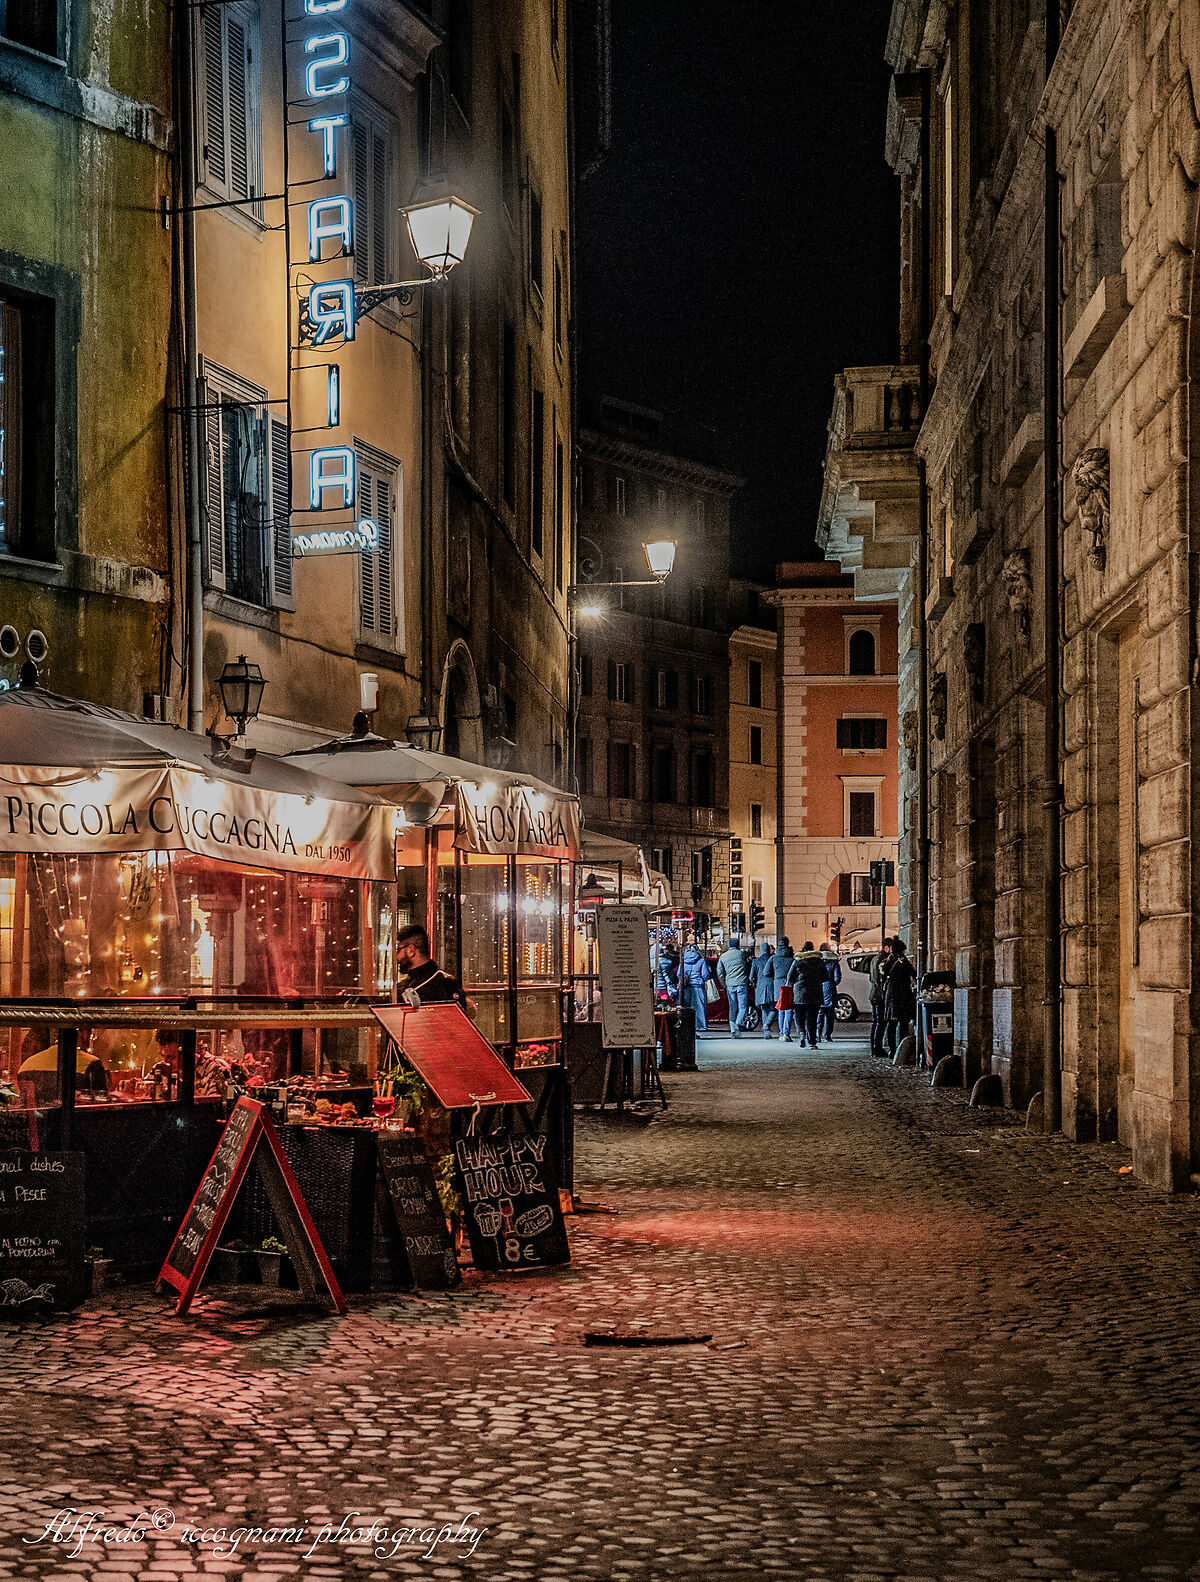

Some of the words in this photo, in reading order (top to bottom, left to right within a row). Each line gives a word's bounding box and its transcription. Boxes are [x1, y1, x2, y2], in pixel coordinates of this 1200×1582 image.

[4, 795, 141, 836] PICCOLA
[149, 796, 298, 856] CUCCAGNA
[305, 844, 325, 860] DAL
[329, 845, 351, 863] 1950
[30, 1156, 65, 1173] dishes
[455, 1134, 547, 1172] HAPPY
[14, 1186, 47, 1202] PESCE
[464, 1163, 546, 1203] HOUR
